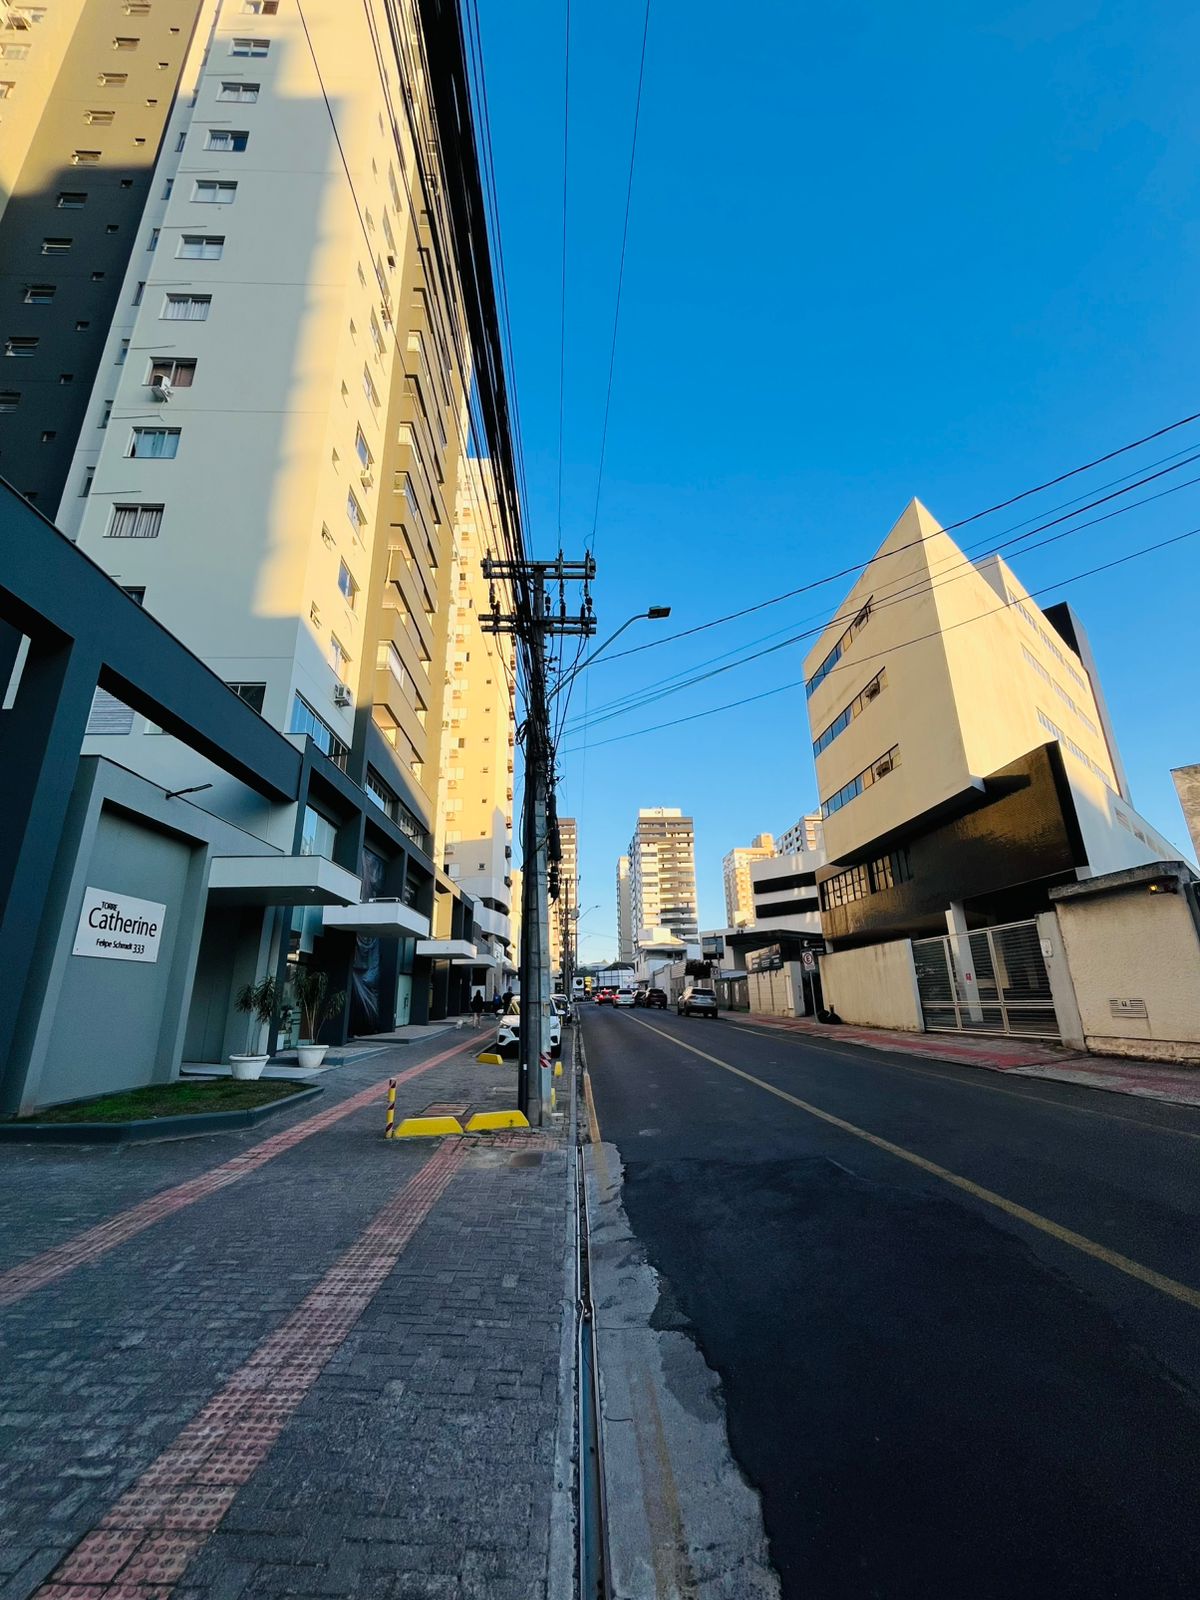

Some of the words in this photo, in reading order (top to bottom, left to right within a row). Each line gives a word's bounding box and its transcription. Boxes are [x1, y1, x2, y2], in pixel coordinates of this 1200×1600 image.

[102, 901, 118, 911] TORRE
[89, 907, 157, 937] Catherine
[96, 939, 112, 948] Felipe
[132, 944, 145, 954] 333
